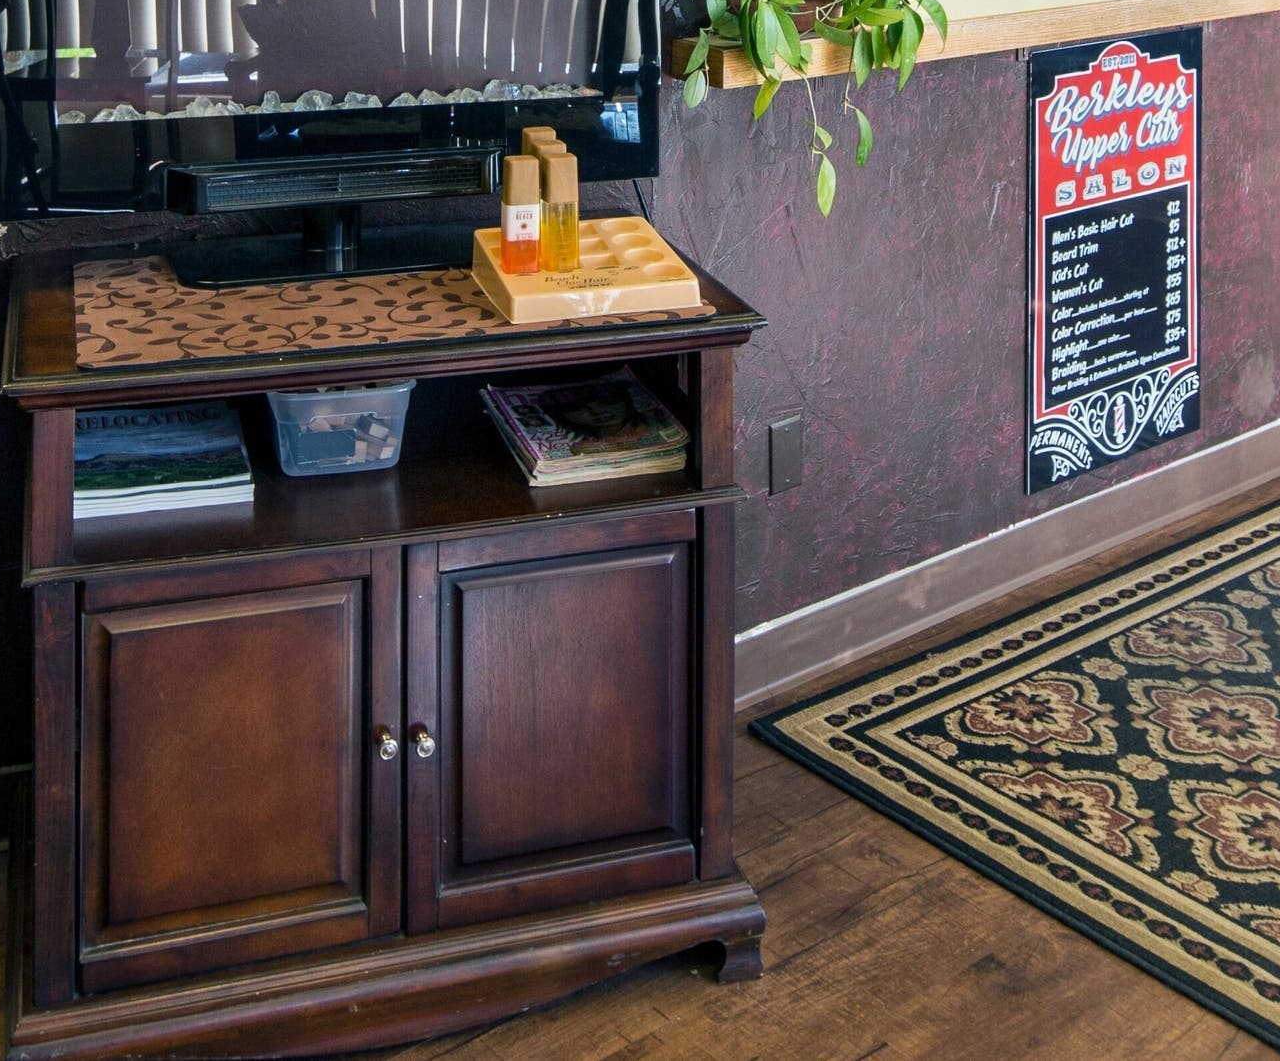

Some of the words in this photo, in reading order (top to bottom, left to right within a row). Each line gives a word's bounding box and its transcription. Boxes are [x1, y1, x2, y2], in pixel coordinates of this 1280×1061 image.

[1044, 69, 1193, 133] Berkleys
[1051, 122, 1134, 172] Upper
[1136, 109, 1182, 147] Cuts
[1056, 155, 1187, 206] SALON
[1166, 199, 1181, 217] $12
[1051, 227, 1076, 245] Men's
[1077, 221, 1099, 239] Basic
[1100, 216, 1119, 233] Hair
[1119, 212, 1135, 228] Cut
[1169, 218, 1180, 234] $5
[1051, 245, 1078, 265] Beard
[1079, 241, 1099, 258] Trim
[1051, 266, 1073, 284] Kid's
[1073, 262, 1090, 278] Cut
[1166, 271, 1183, 289] $55
[1051, 281, 1088, 304] Women's
[1088, 277, 1105, 293] Cut
[1165, 290, 1182, 308] $65
[1166, 308, 1182, 326] $75
[1051, 325, 1074, 343] Color
[1165, 326, 1187, 345] $35+
[1051, 384, 1068, 395] Other
[1155, 375, 1200, 432] HAIRCUTS
[75, 407, 217, 431] RELOCATING
[1029, 429, 1093, 470] PERMANENTS
